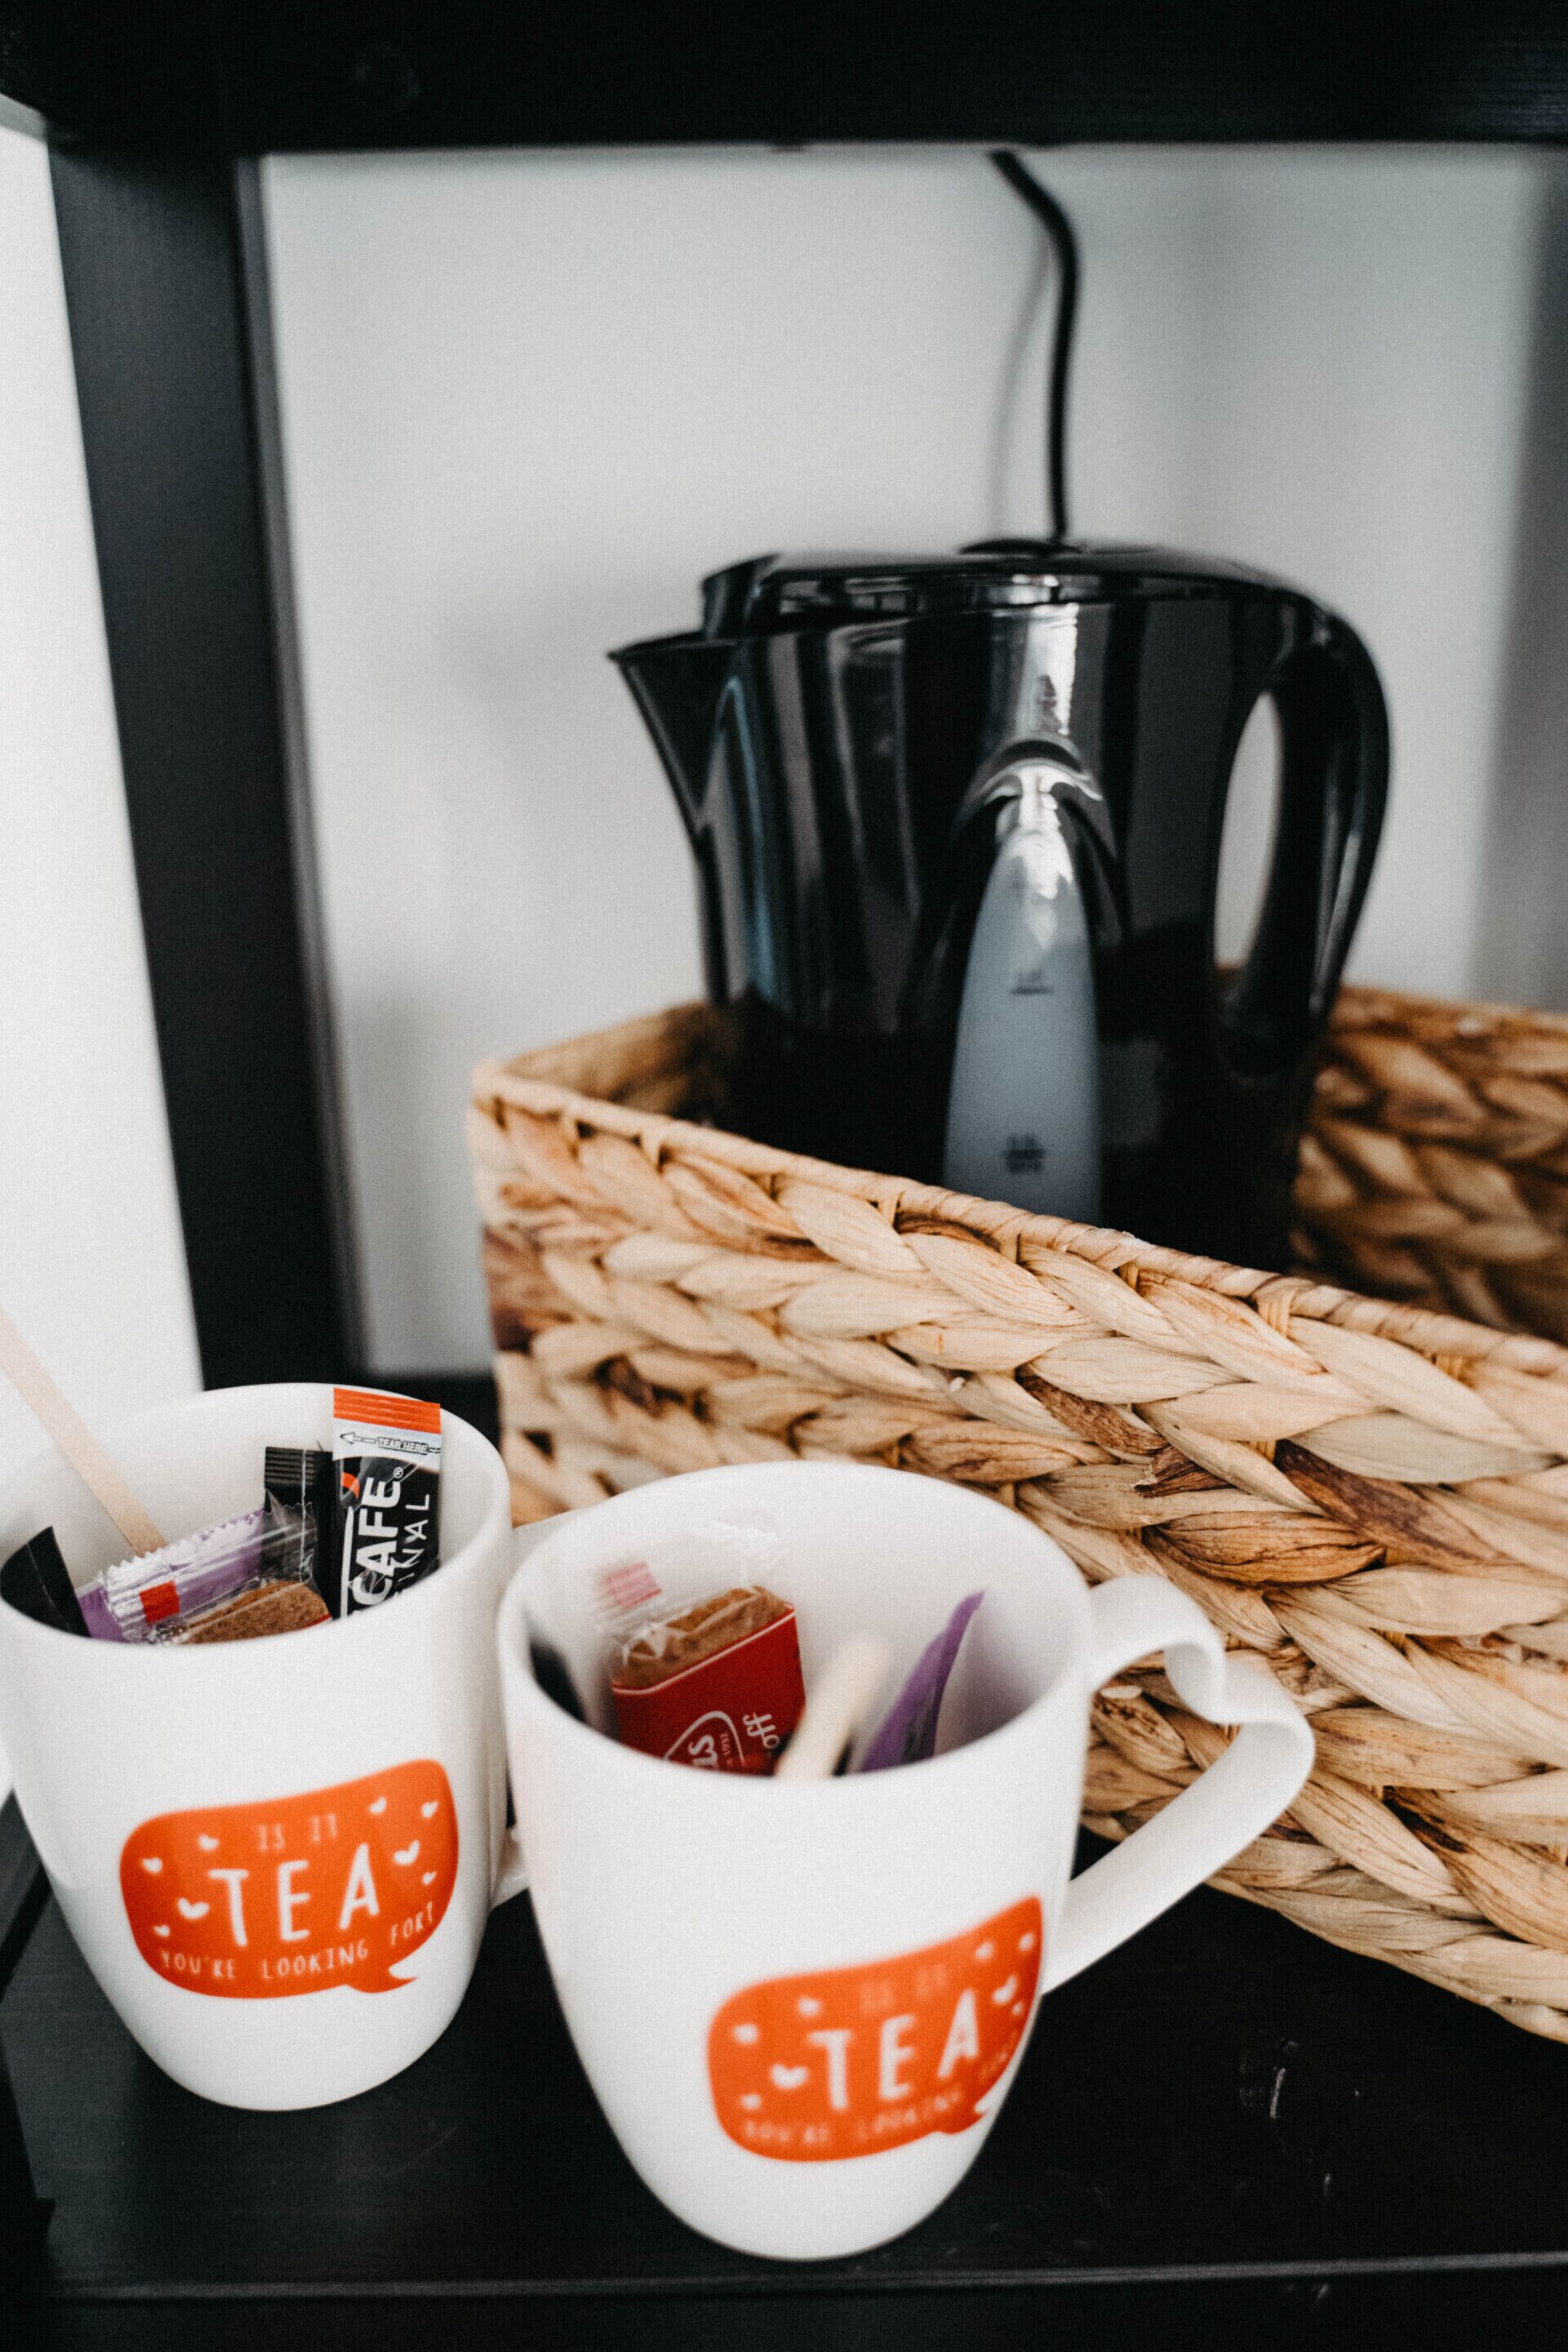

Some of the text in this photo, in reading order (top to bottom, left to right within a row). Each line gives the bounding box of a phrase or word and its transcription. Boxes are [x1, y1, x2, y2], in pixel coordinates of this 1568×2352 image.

[377, 1437, 429, 1455] TEAR HERE
[743, 1712, 780, 1750] off
[207, 1842, 380, 1948] TEA
[159, 1948, 236, 1980] YOU'RE
[262, 1937, 370, 1981] LOOKING
[806, 1989, 979, 2112] TEA
